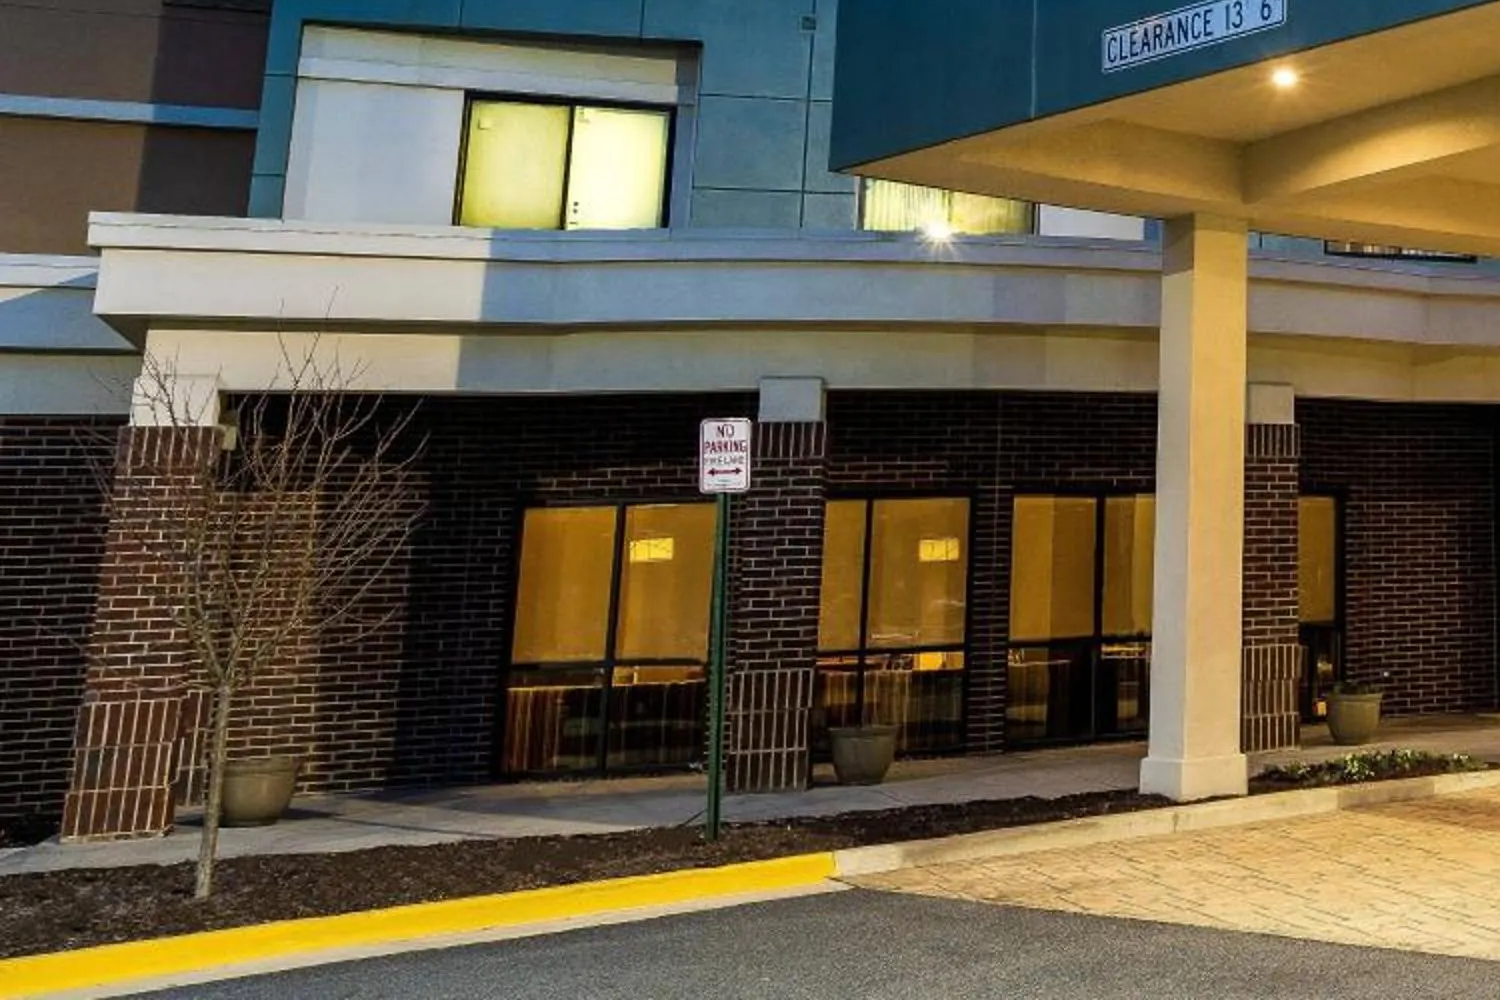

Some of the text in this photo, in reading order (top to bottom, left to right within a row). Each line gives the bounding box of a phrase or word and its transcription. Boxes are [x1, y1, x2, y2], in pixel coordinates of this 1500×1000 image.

[1107, 9, 1214, 63] CLEARANCE
[717, 424, 735, 438] NO
[704, 440, 747, 453] PARKING
